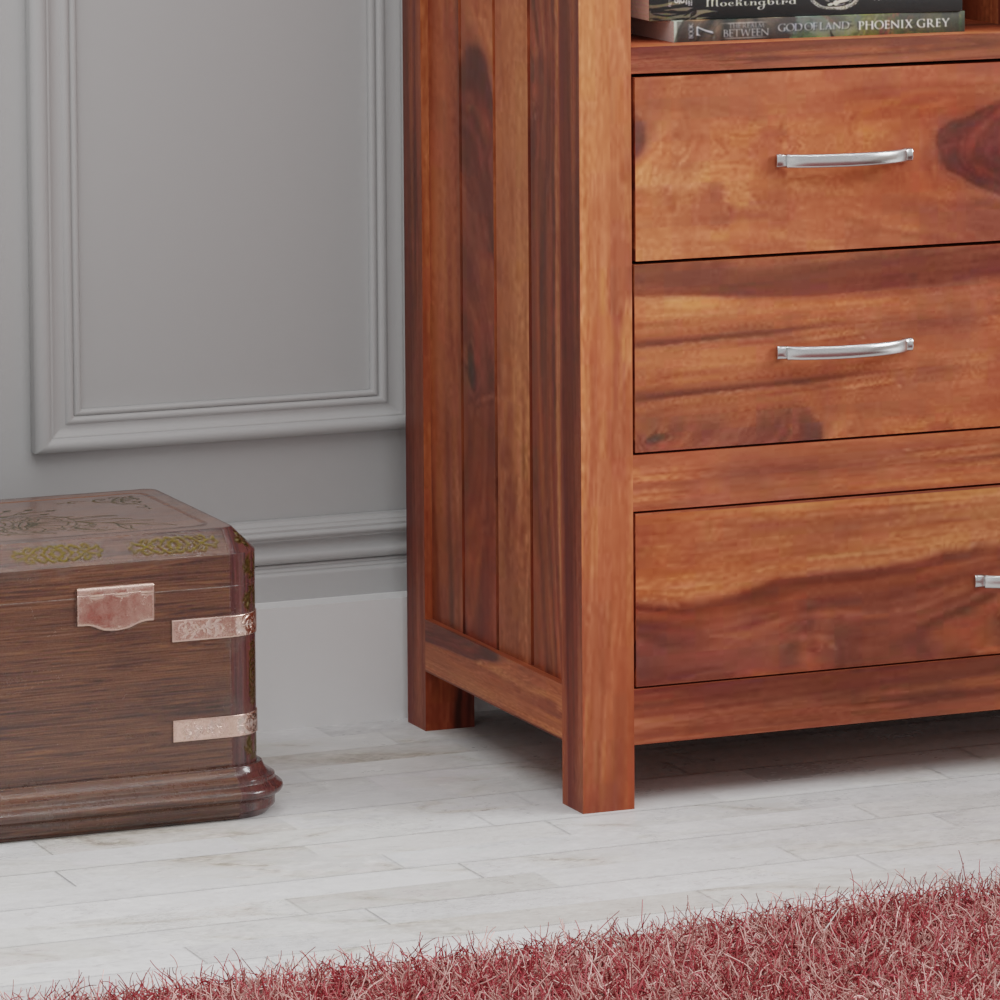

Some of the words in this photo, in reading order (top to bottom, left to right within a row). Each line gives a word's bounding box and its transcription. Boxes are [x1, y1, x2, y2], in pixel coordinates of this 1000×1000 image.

[777, 23, 803, 32] GOD
[805, 22, 817, 32] OF
[820, 21, 850, 30] LAND
[858, 19, 913, 31] PHOENIX
[916, 18, 950, 28] GREY
[696, 26, 714, 37] 7
[723, 28, 769, 38] BETWEEN
